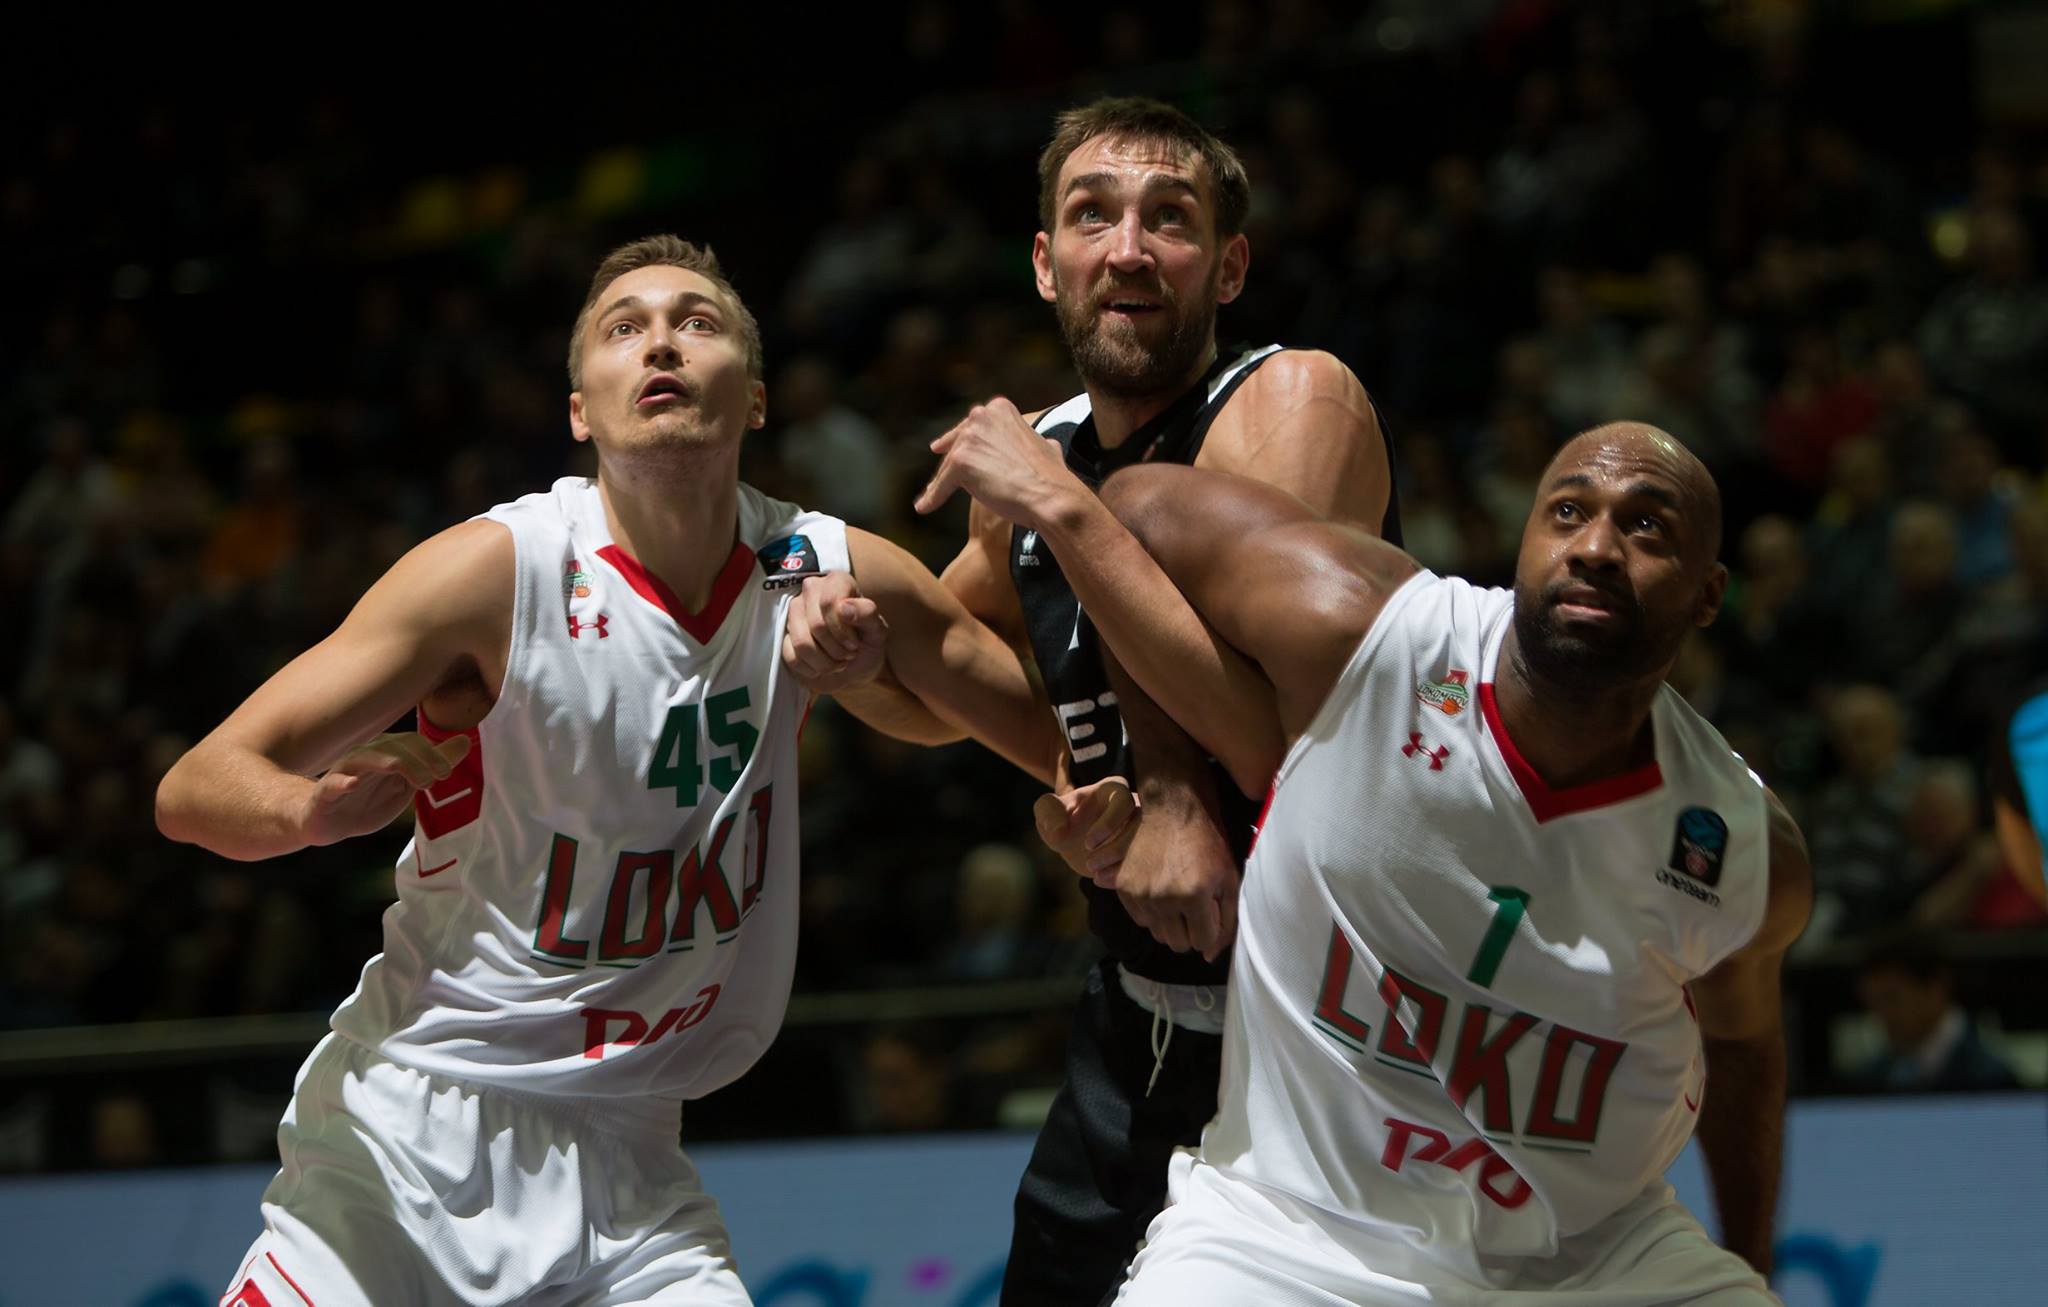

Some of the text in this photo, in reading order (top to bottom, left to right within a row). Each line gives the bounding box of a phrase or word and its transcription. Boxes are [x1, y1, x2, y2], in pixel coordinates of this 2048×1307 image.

[648, 686, 760, 808] 45
[532, 782, 774, 961] LOKO
[1467, 885, 1532, 989] 1
[1313, 917, 1629, 1144] LOKO
